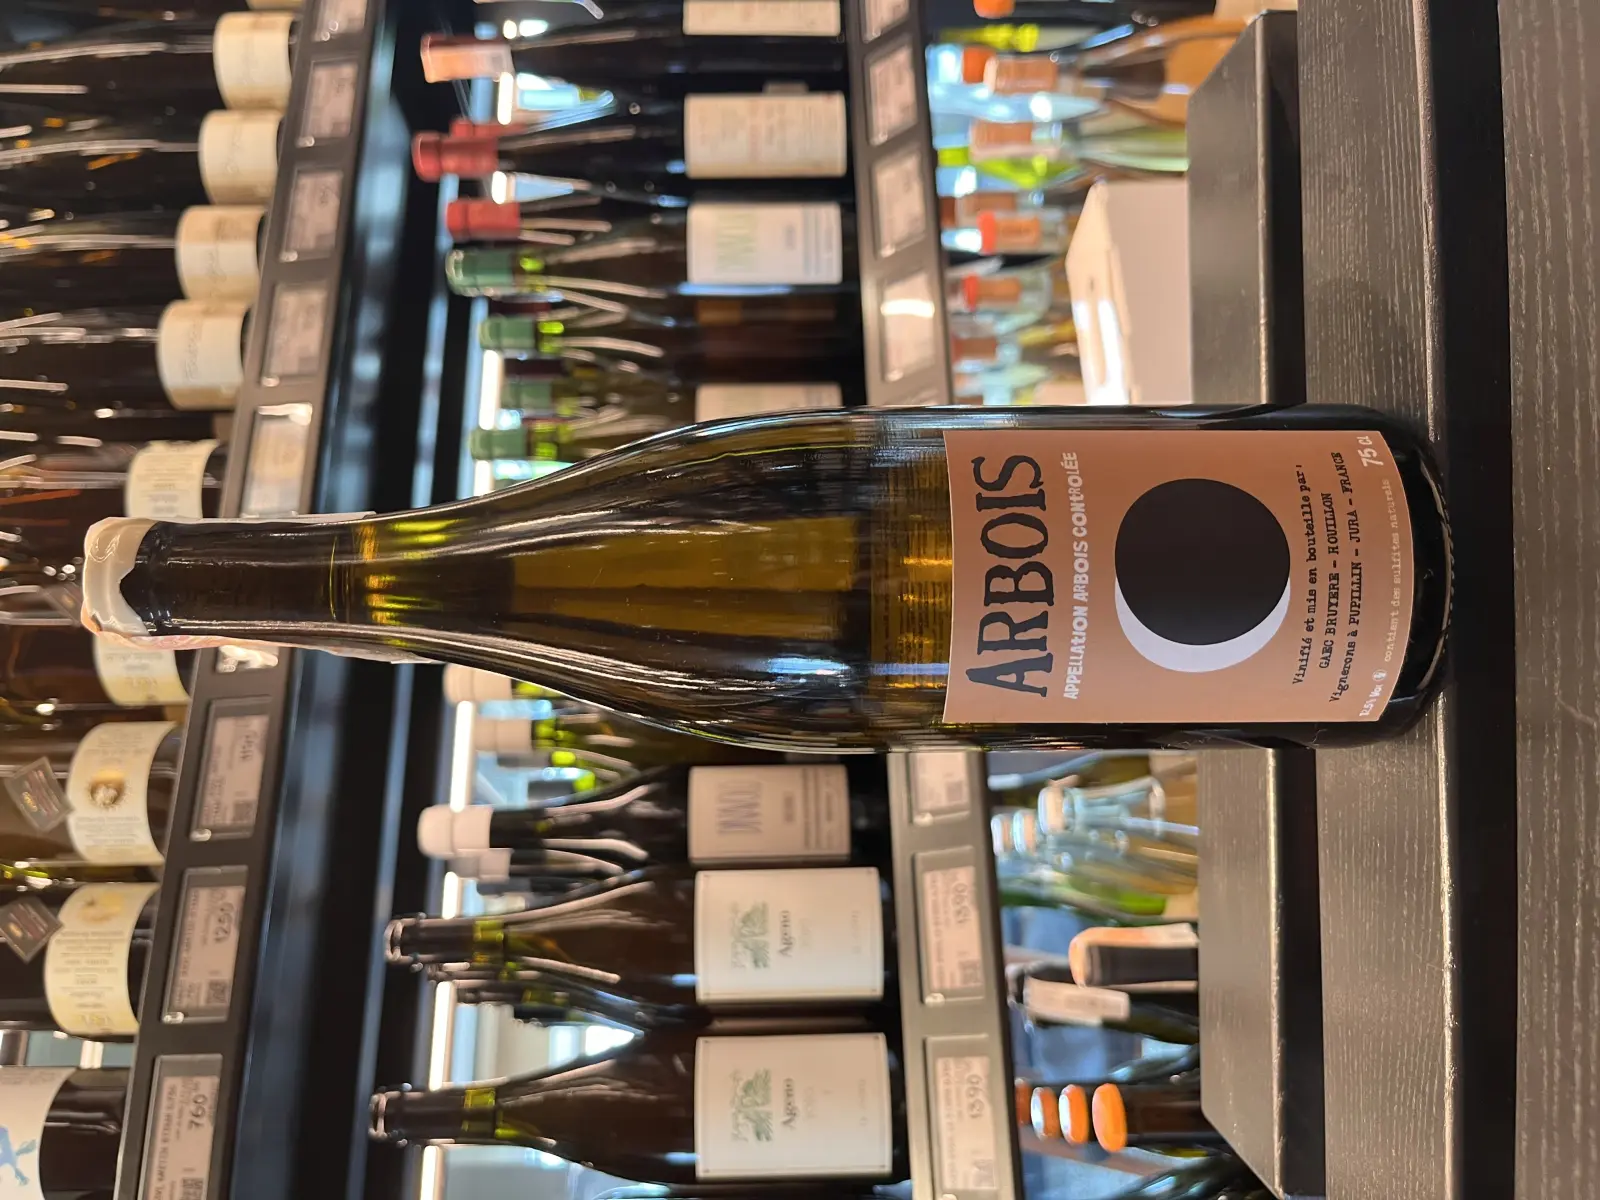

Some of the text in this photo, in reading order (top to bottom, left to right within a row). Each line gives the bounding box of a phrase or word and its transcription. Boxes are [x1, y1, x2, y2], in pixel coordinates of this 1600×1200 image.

[1331, 452, 1353, 494] FRANCE
[1357, 448, 1384, 467] 75
[1301, 496, 1317, 562] bouteille
[1321, 492, 1339, 555] HOUILLON
[1347, 510, 1360, 543] JURA
[965, 455, 1054, 697] ARBOIS
[1072, 540, 1089, 602] ARBOIS
[1308, 568, 1317, 584] en
[1391, 532, 1401, 584] sulfites
[1306, 589, 1316, 613] mis
[1325, 573, 1340, 636] BRUYERE
[1348, 562, 1362, 625] PUPILLIN
[1390, 588, 1400, 607] des
[1304, 618, 1315, 632] et
[1384, 610, 1399, 662] contient
[1292, 638, 1312, 684] Vinifié
[1319, 640, 1334, 668] GAEC
[1329, 641, 1356, 702] Vignerons
[778, 910, 796, 958] Ageno
[781, 1078, 798, 1130] Ageno
